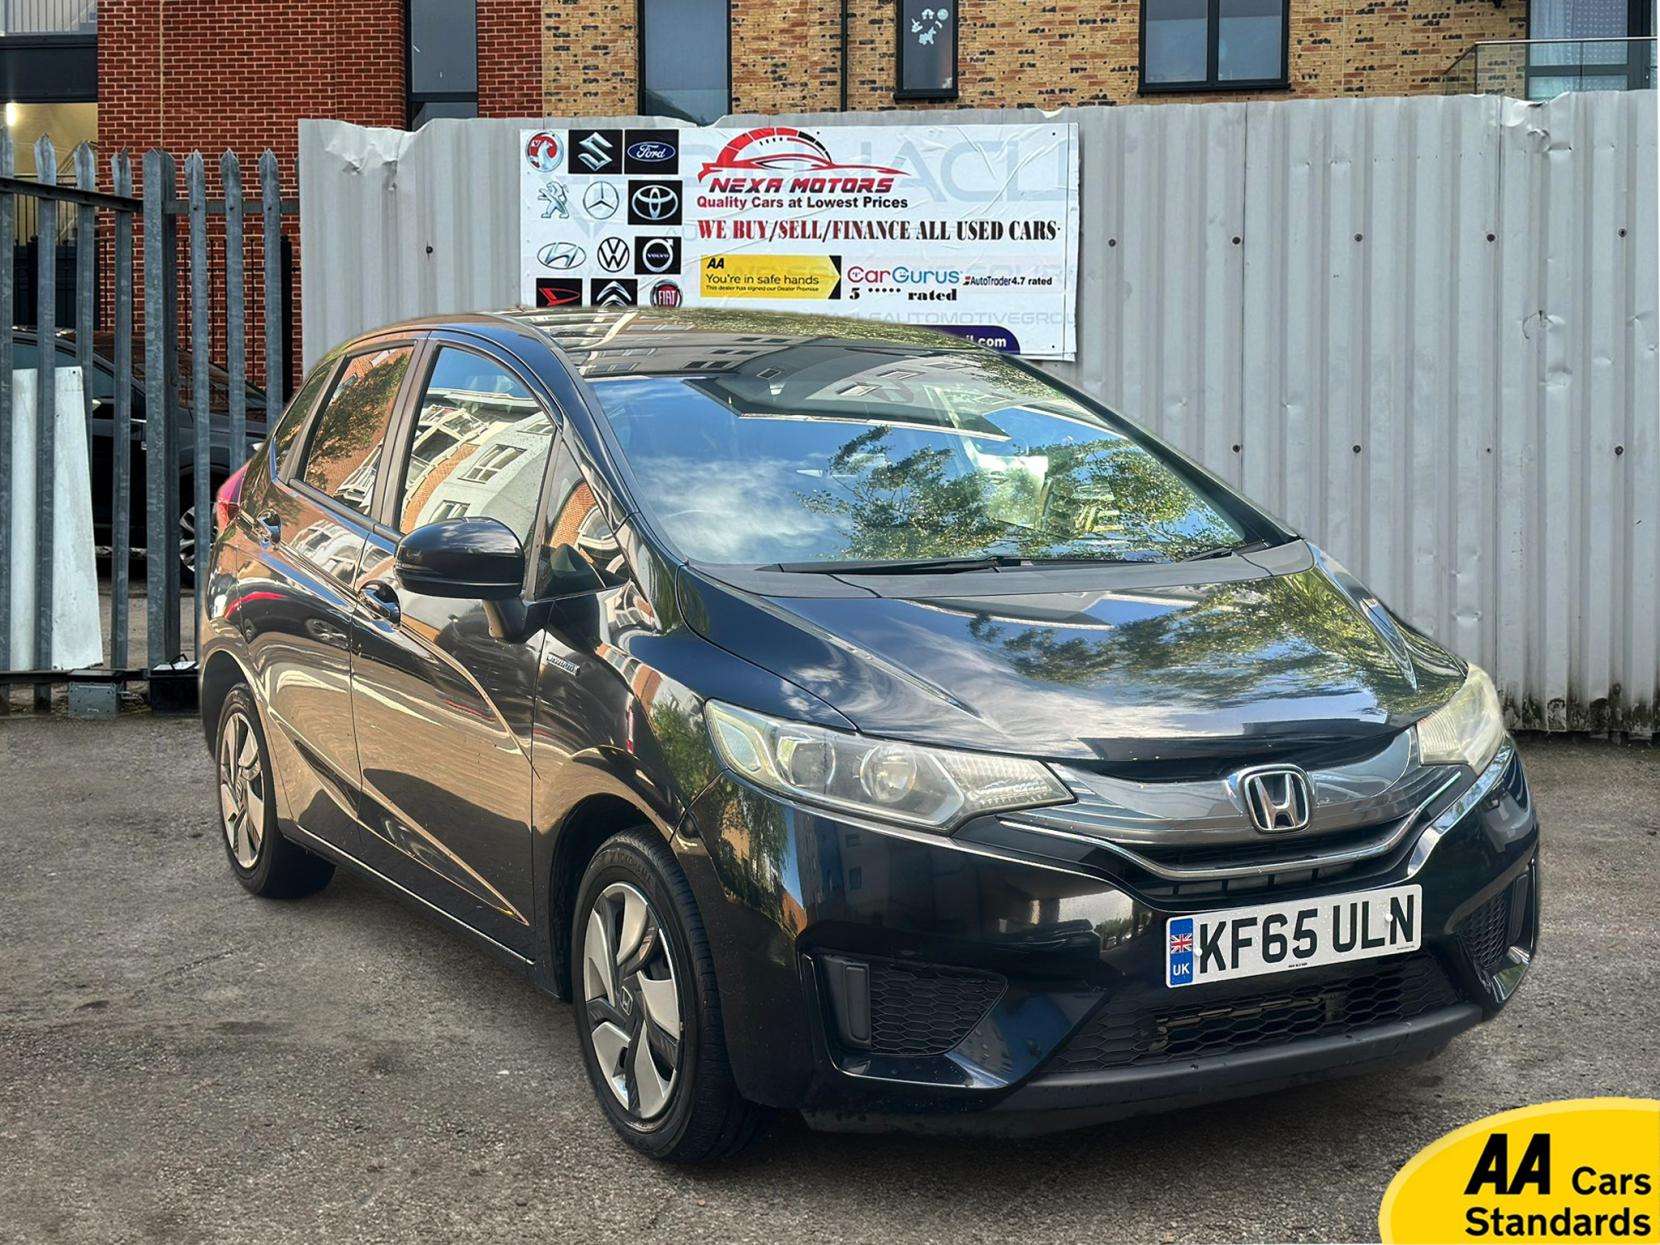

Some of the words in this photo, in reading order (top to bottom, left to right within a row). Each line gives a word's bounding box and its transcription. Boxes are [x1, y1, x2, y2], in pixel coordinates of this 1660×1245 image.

[636, 144, 666, 158] Ford
[709, 178, 783, 194] NEXA
[789, 178, 895, 194] MOTORS
[697, 196, 747, 211] Quality
[752, 196, 784, 208] Cars
[788, 197, 803, 208] at
[807, 196, 859, 208] Lowest
[863, 196, 909, 208] Prices
[697, 220, 727, 239] WE
[733, 220, 911, 242] BUY/SELL/FINANCE
[916, 220, 951, 240] ALL
[956, 220, 1004, 240] USED
[706, 258, 725, 269] AA
[705, 273, 741, 284] You're
[744, 273, 754, 284] in
[757, 273, 781, 285] safe
[784, 274, 820, 285] hands
[847, 266, 960, 284] CarGurus
[1028, 277, 1053, 286] rated
[658, 290, 676, 305] FIAT
[849, 287, 860, 300] 5
[908, 288, 957, 301] rated
[1199, 908, 1318, 974] KF65
[1332, 894, 1415, 954] ULN
[1173, 962, 1190, 976] UK
